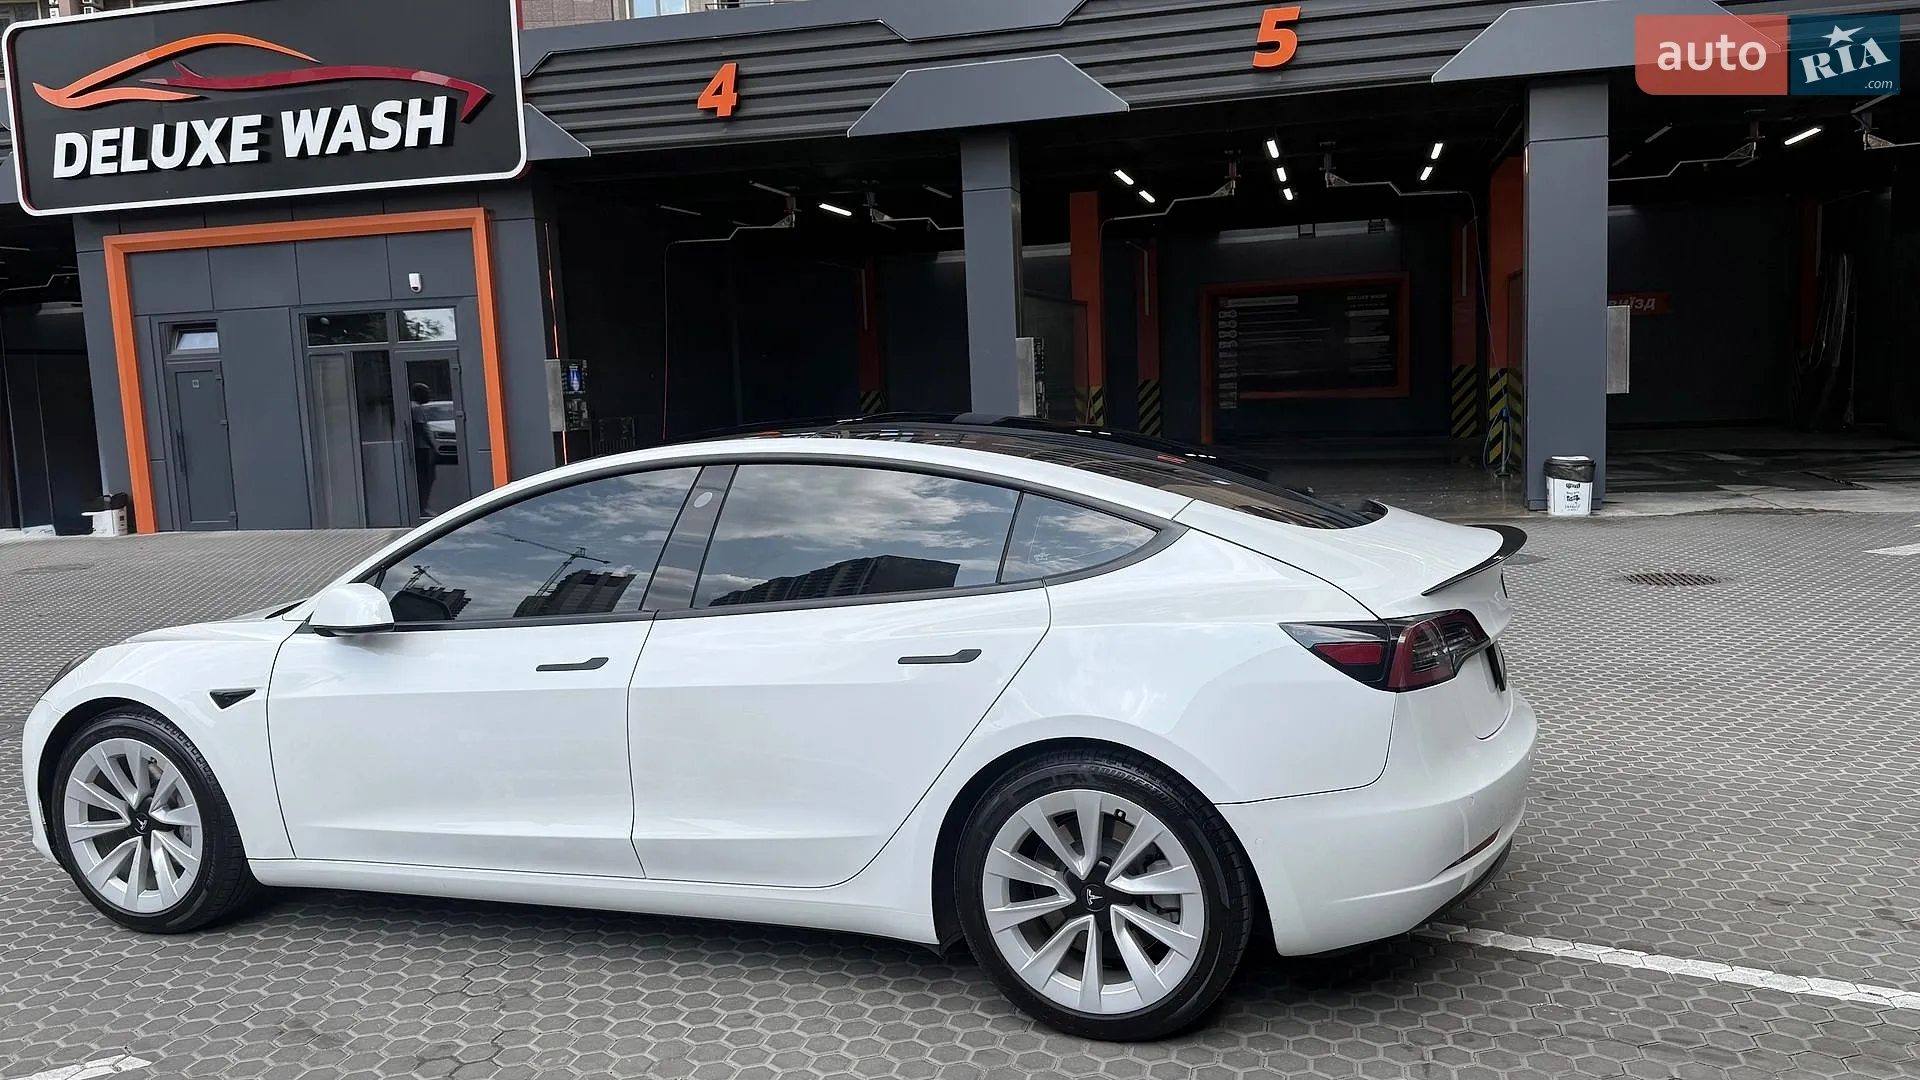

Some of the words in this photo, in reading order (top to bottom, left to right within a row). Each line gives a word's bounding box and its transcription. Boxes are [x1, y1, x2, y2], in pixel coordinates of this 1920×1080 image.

[1252, 5, 1302, 68] 5
[697, 62, 738, 117] 4
[53, 113, 263, 179] DELUXE
[280, 95, 448, 158] WASH
